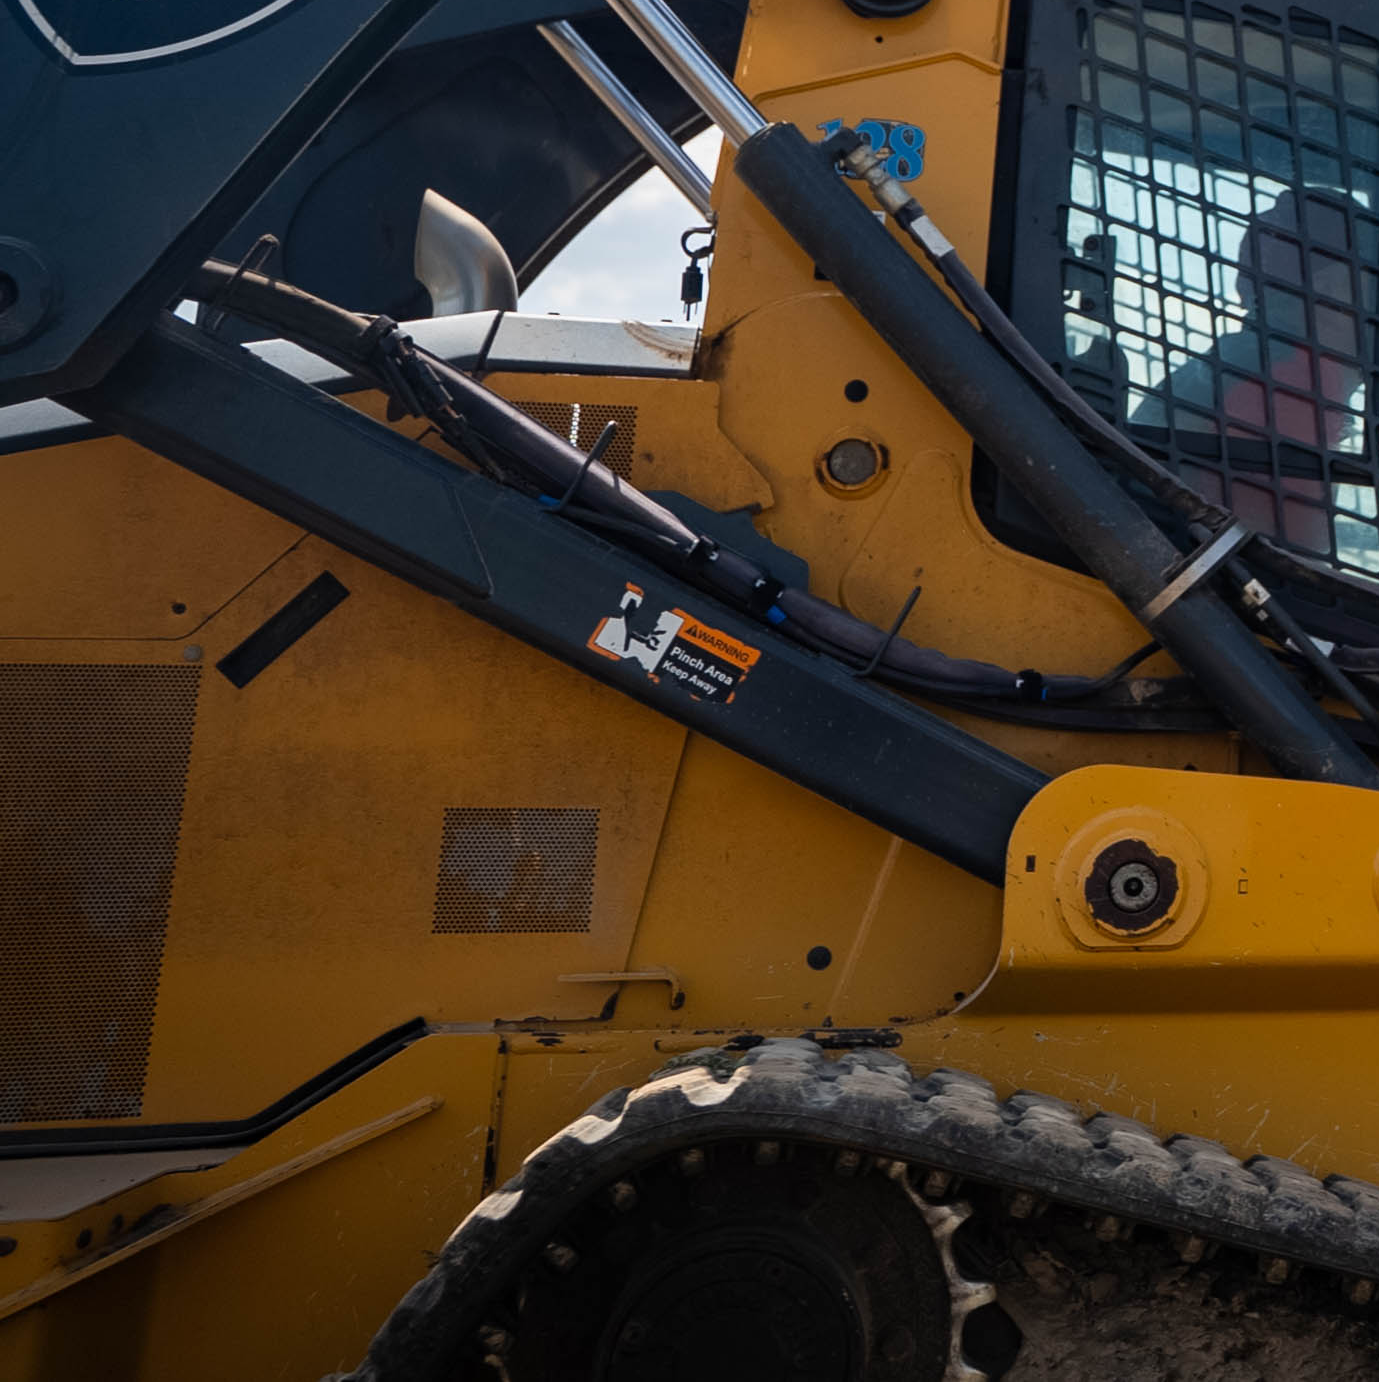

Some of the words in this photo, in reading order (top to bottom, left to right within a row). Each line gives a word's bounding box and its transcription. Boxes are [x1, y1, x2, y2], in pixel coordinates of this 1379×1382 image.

[697, 628, 751, 664] WARNING
[661, 659, 690, 682] Keep
[687, 673, 718, 696] Away
[669, 645, 705, 673] Pinch
[702, 665, 734, 687] Area
